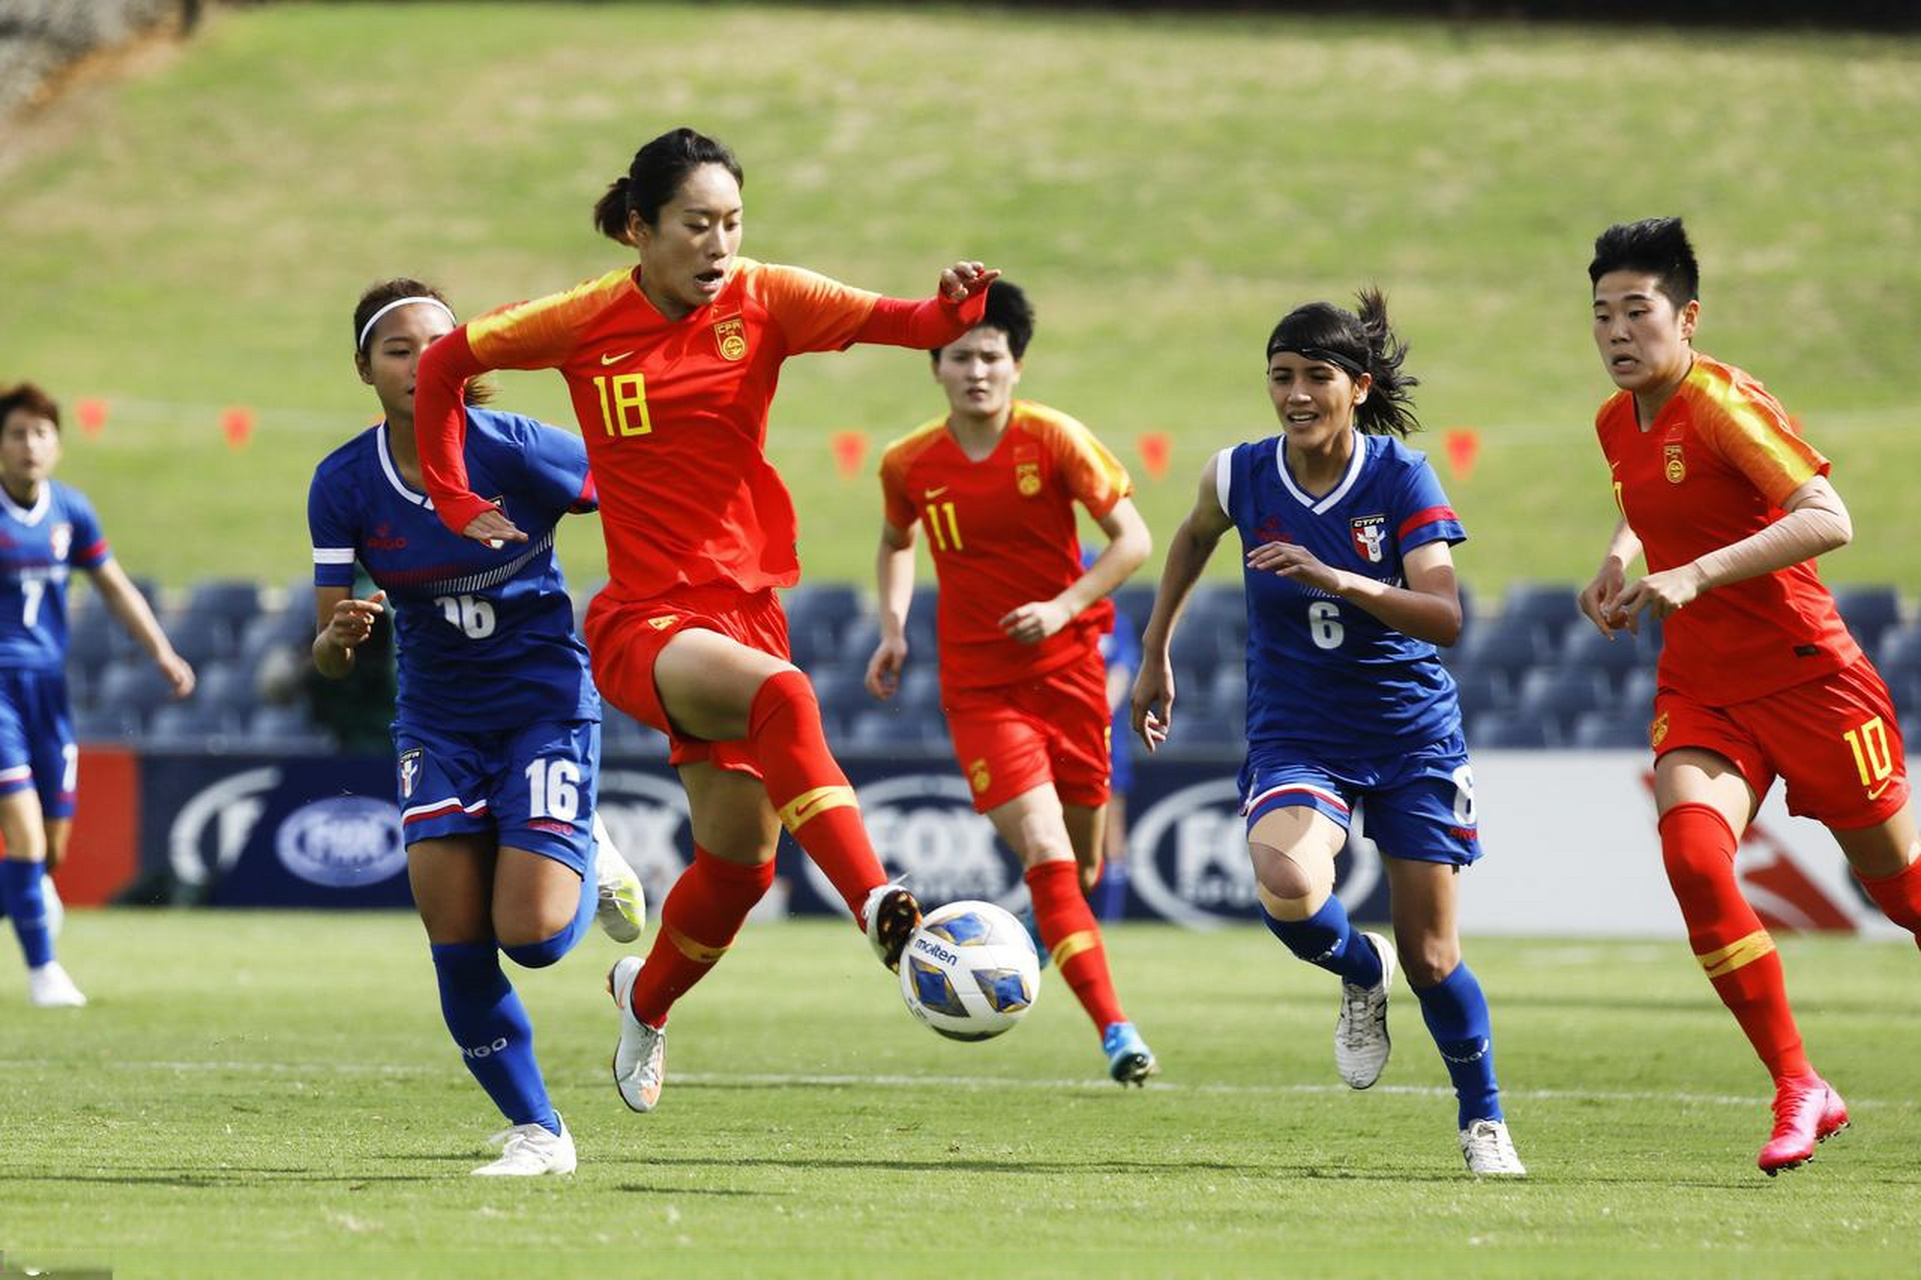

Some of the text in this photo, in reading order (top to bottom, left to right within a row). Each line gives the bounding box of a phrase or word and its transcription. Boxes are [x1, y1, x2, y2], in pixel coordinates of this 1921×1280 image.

[593, 373, 652, 437] 18
[926, 502, 962, 551] 11
[1354, 517, 1385, 528] CTFA
[433, 595, 497, 640] 16
[1308, 601, 1345, 650] 6
[1843, 716, 1893, 786] 10
[525, 758, 581, 822] 16
[915, 939, 957, 966] molten
